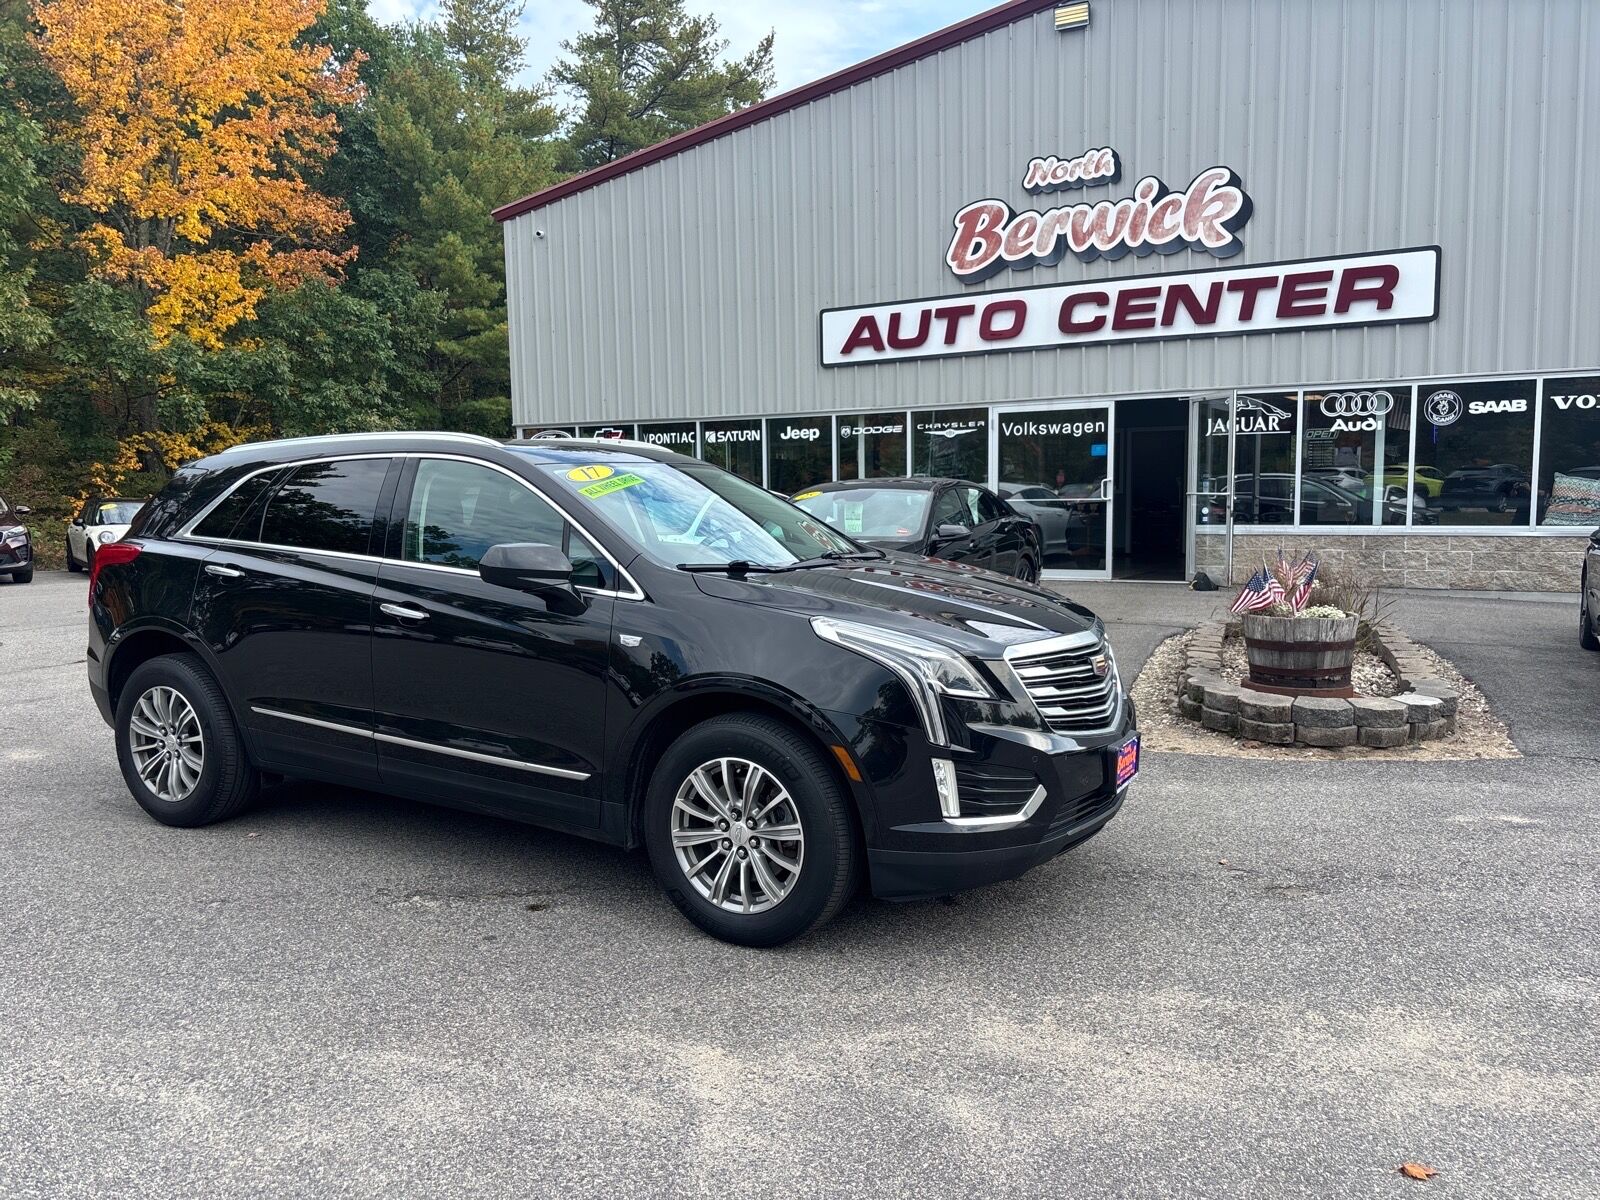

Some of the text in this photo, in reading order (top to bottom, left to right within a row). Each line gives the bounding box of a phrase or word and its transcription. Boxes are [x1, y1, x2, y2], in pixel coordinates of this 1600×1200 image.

[1024, 149, 1115, 187] North
[948, 169, 1240, 272] Berwick
[840, 264, 1401, 354] AUTO CENTER
[1468, 399, 1527, 414] SAAB
[852, 425, 904, 435] DODGE
[917, 421, 985, 429] CHRYSLER
[1002, 422, 1105, 436] Volkswagen
[1330, 418, 1383, 432] Audi
[649, 431, 695, 444] PONTIAC
[717, 430, 760, 442] SATURN
[780, 426, 820, 441] Jeep
[1306, 430, 1338, 438] OPEN
[580, 466, 601, 480] 17
